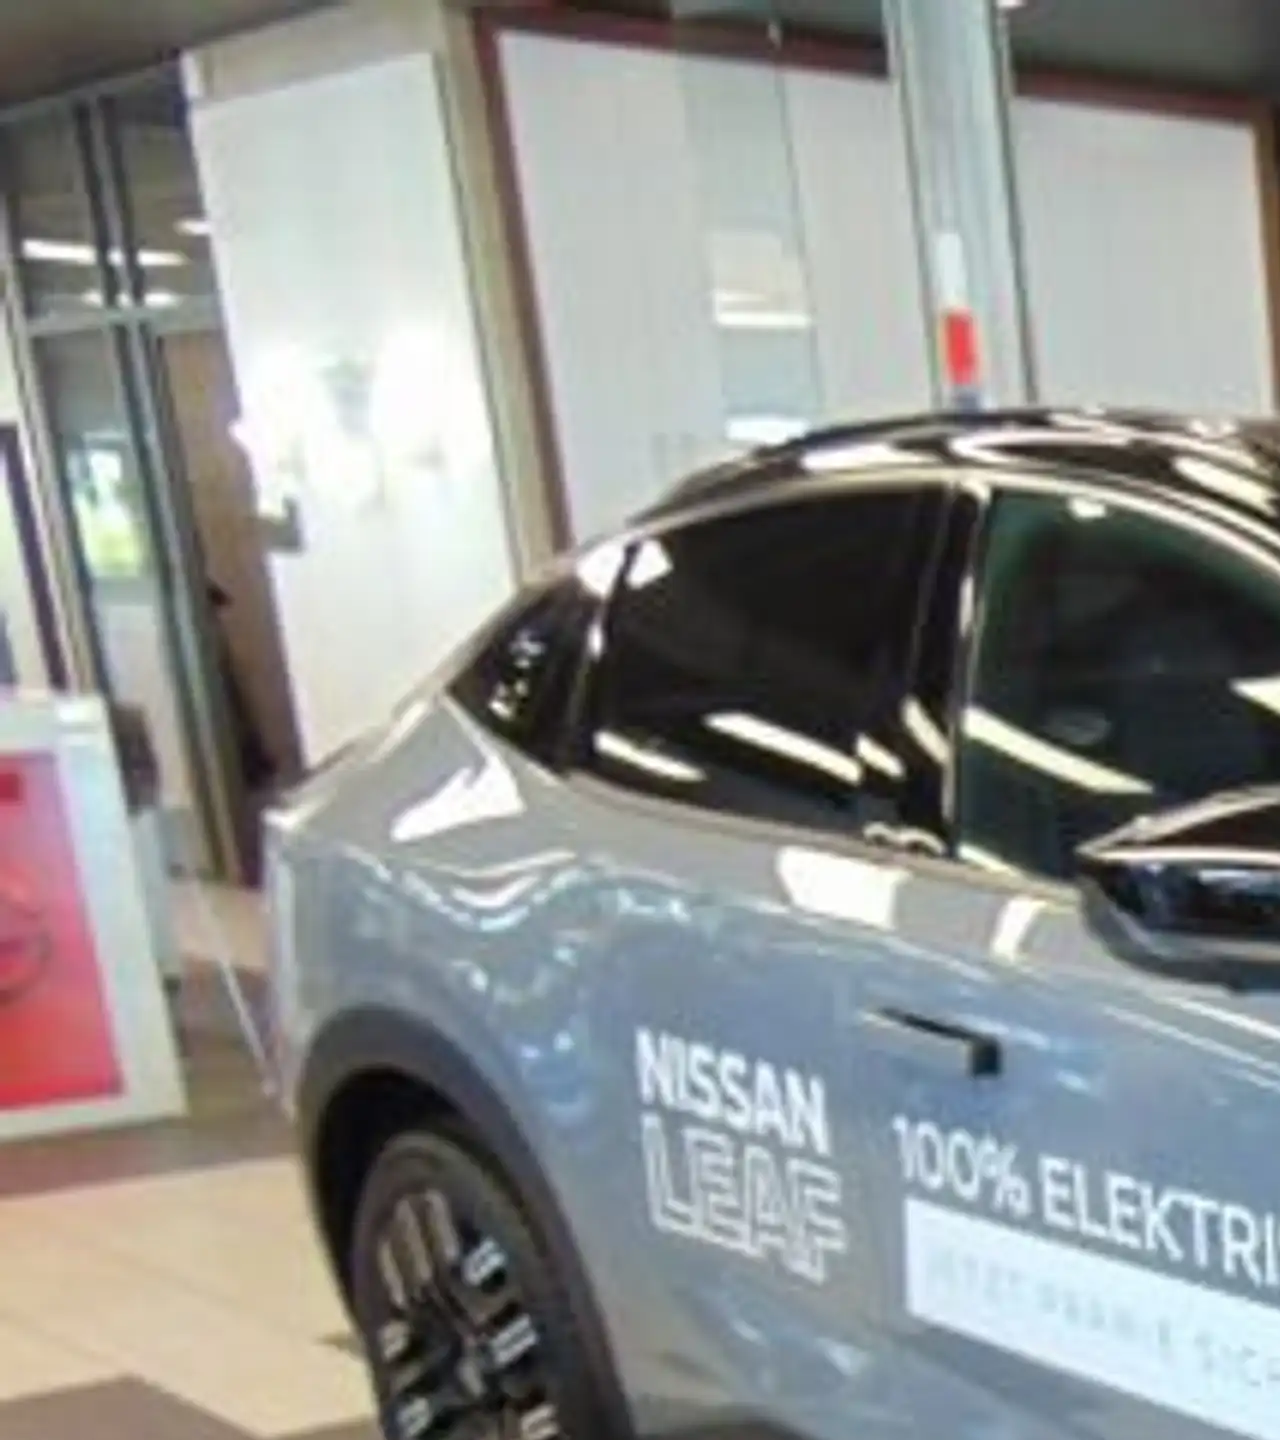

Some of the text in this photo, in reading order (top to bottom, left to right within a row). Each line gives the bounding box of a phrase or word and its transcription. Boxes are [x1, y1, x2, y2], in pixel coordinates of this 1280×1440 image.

[635, 1026, 831, 1156] NISSAN
[641, 1112, 846, 1286] LEAF
[893, 1114, 1031, 1219] 100%
